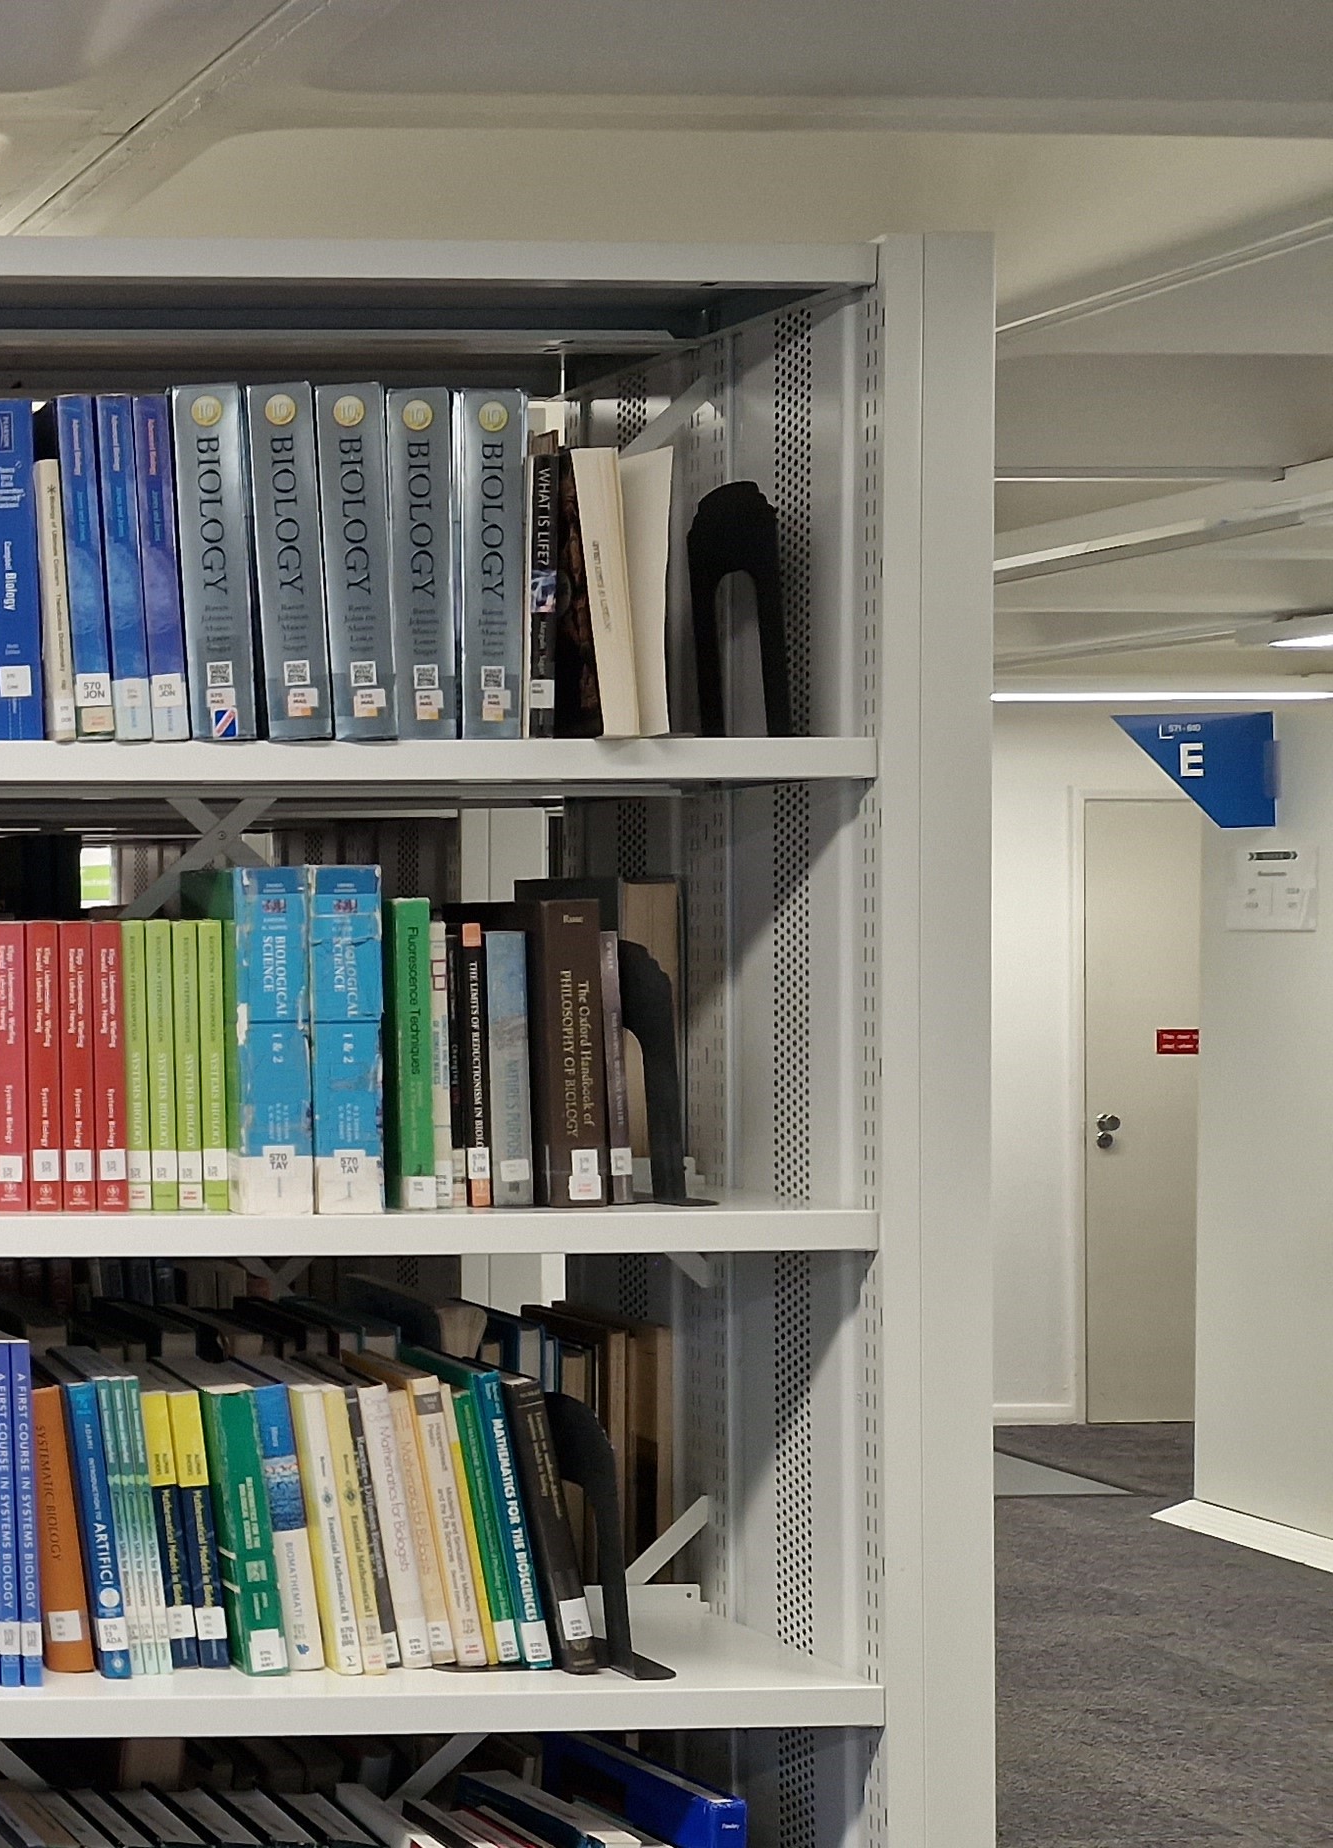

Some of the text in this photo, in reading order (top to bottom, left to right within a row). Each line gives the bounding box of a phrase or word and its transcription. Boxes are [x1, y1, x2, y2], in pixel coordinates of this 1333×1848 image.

[4, 572, 16, 610] Biology
[196, 435, 228, 595] BIOLOGY
[270, 435, 304, 595] BIOLOGY
[339, 435, 371, 596] BIOLOGY
[407, 440, 435, 599] BIOLOGY
[480, 441, 505, 601] BIOLOGY
[537, 468, 551, 565] WHAT IS LIFE?
[1180, 743, 1204, 777] E
[261, 936, 274, 993] SCIENCE
[274, 936, 287, 1018] BIOLOGICAL
[407, 926, 421, 1075] Fluorescence Techniques
[560, 970, 578, 1137] PHILOSOPHY OF BIOLOGY
[577, 981, 594, 1126] The Oxford Handbook of
[491, 1418, 537, 1621] MATHEMATICS FOR THE BIOSCIENCES
